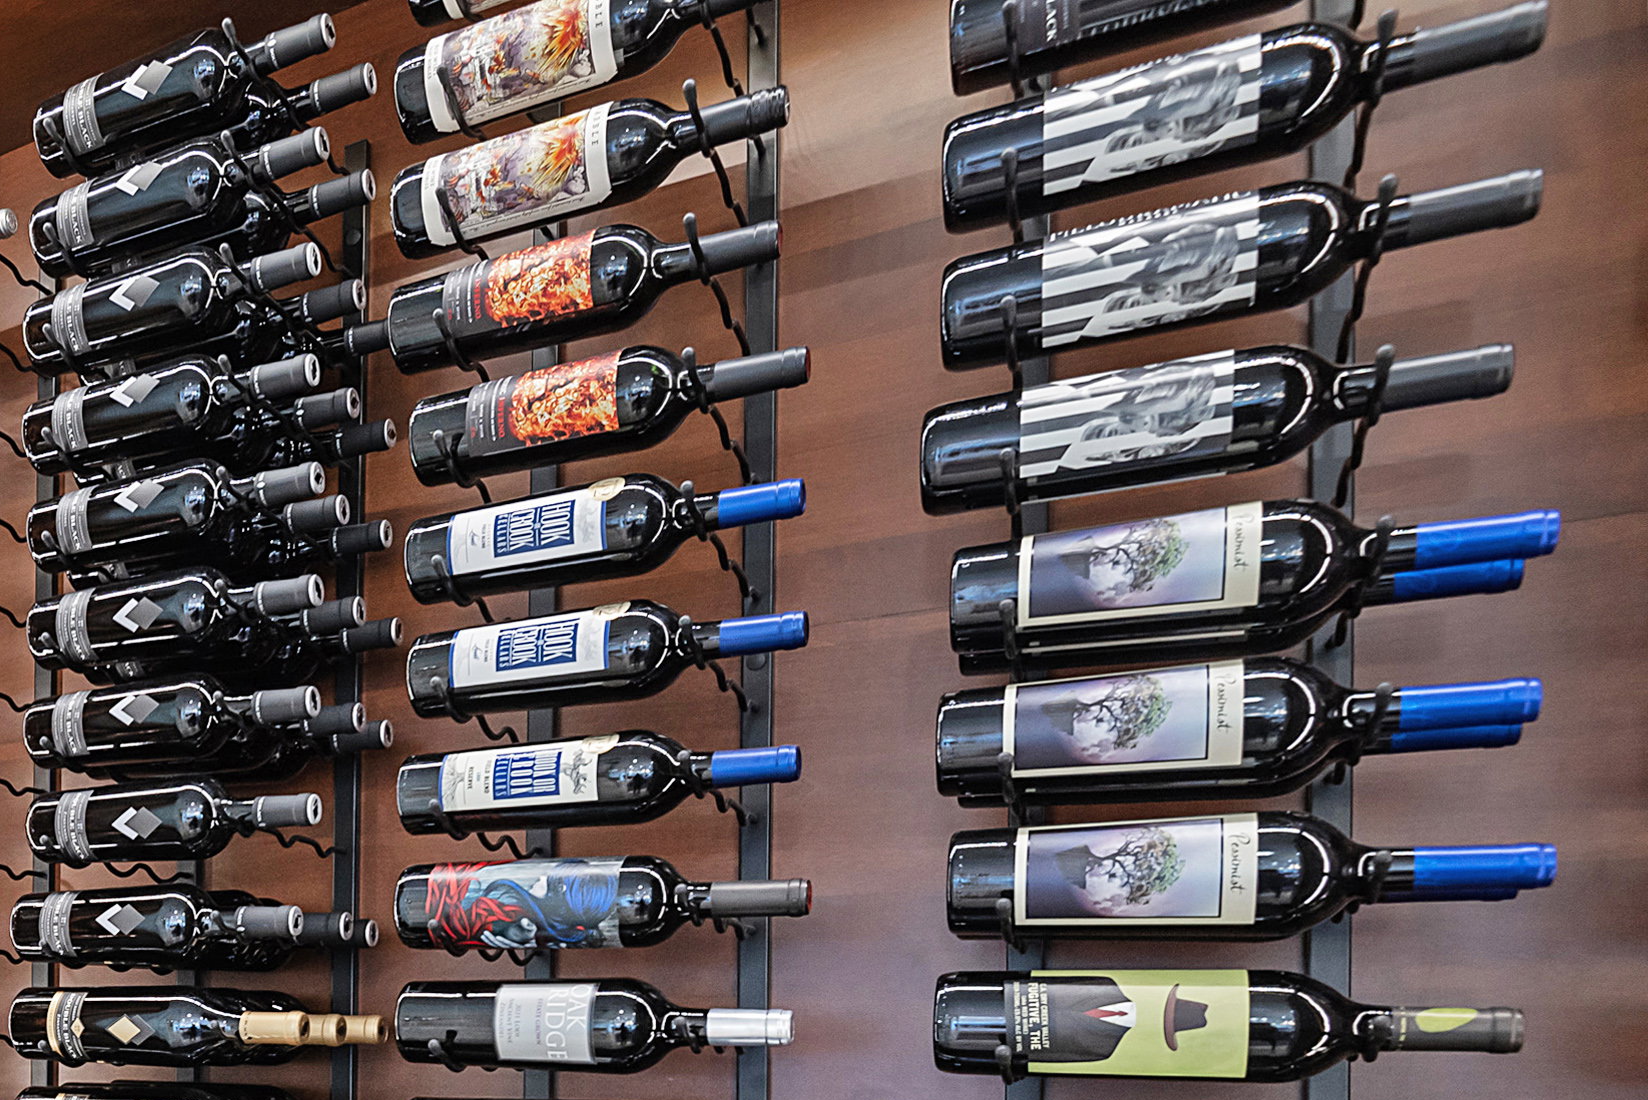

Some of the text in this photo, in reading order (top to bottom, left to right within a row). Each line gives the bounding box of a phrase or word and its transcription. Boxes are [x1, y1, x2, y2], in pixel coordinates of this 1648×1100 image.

[78, 112, 94, 149] BLACK
[71, 210, 82, 244] BLACK
[474, 277, 483, 320] INFERNO
[66, 318, 80, 351] BLACK
[65, 412, 77, 449] BLACK
[498, 396, 506, 438] INFERNO
[70, 516, 82, 551] BLACK
[496, 513, 509, 553] CELLARS
[509, 508, 535, 551] CROOK
[540, 501, 572, 546] HOOK
[1232, 513, 1250, 571] Pessimist
[70, 630, 86, 661] BLACK
[498, 632, 510, 668] CELLARS
[511, 630, 537, 666] CROOK
[542, 624, 575, 663] HOOK
[1215, 674, 1233, 731] Pessimist
[66, 725, 78, 754] BLACK
[495, 755, 507, 797] CELLARS
[510, 755, 534, 796] CROOK
[533, 777, 556, 794] OR
[70, 829, 85, 859] BLACK
[1227, 832, 1247, 893] Pessimist
[53, 925, 64, 955] BLACK
[62, 992, 76, 1060] DOUBLE BLACK
[545, 989, 569, 1059] RIDGE
[566, 984, 592, 1033] OAK
[1028, 982, 1042, 1050] FUGITIVE, THE
[1041, 1005, 1049, 1025] CREEK
[1042, 1027, 1050, 1048] VALLEY
